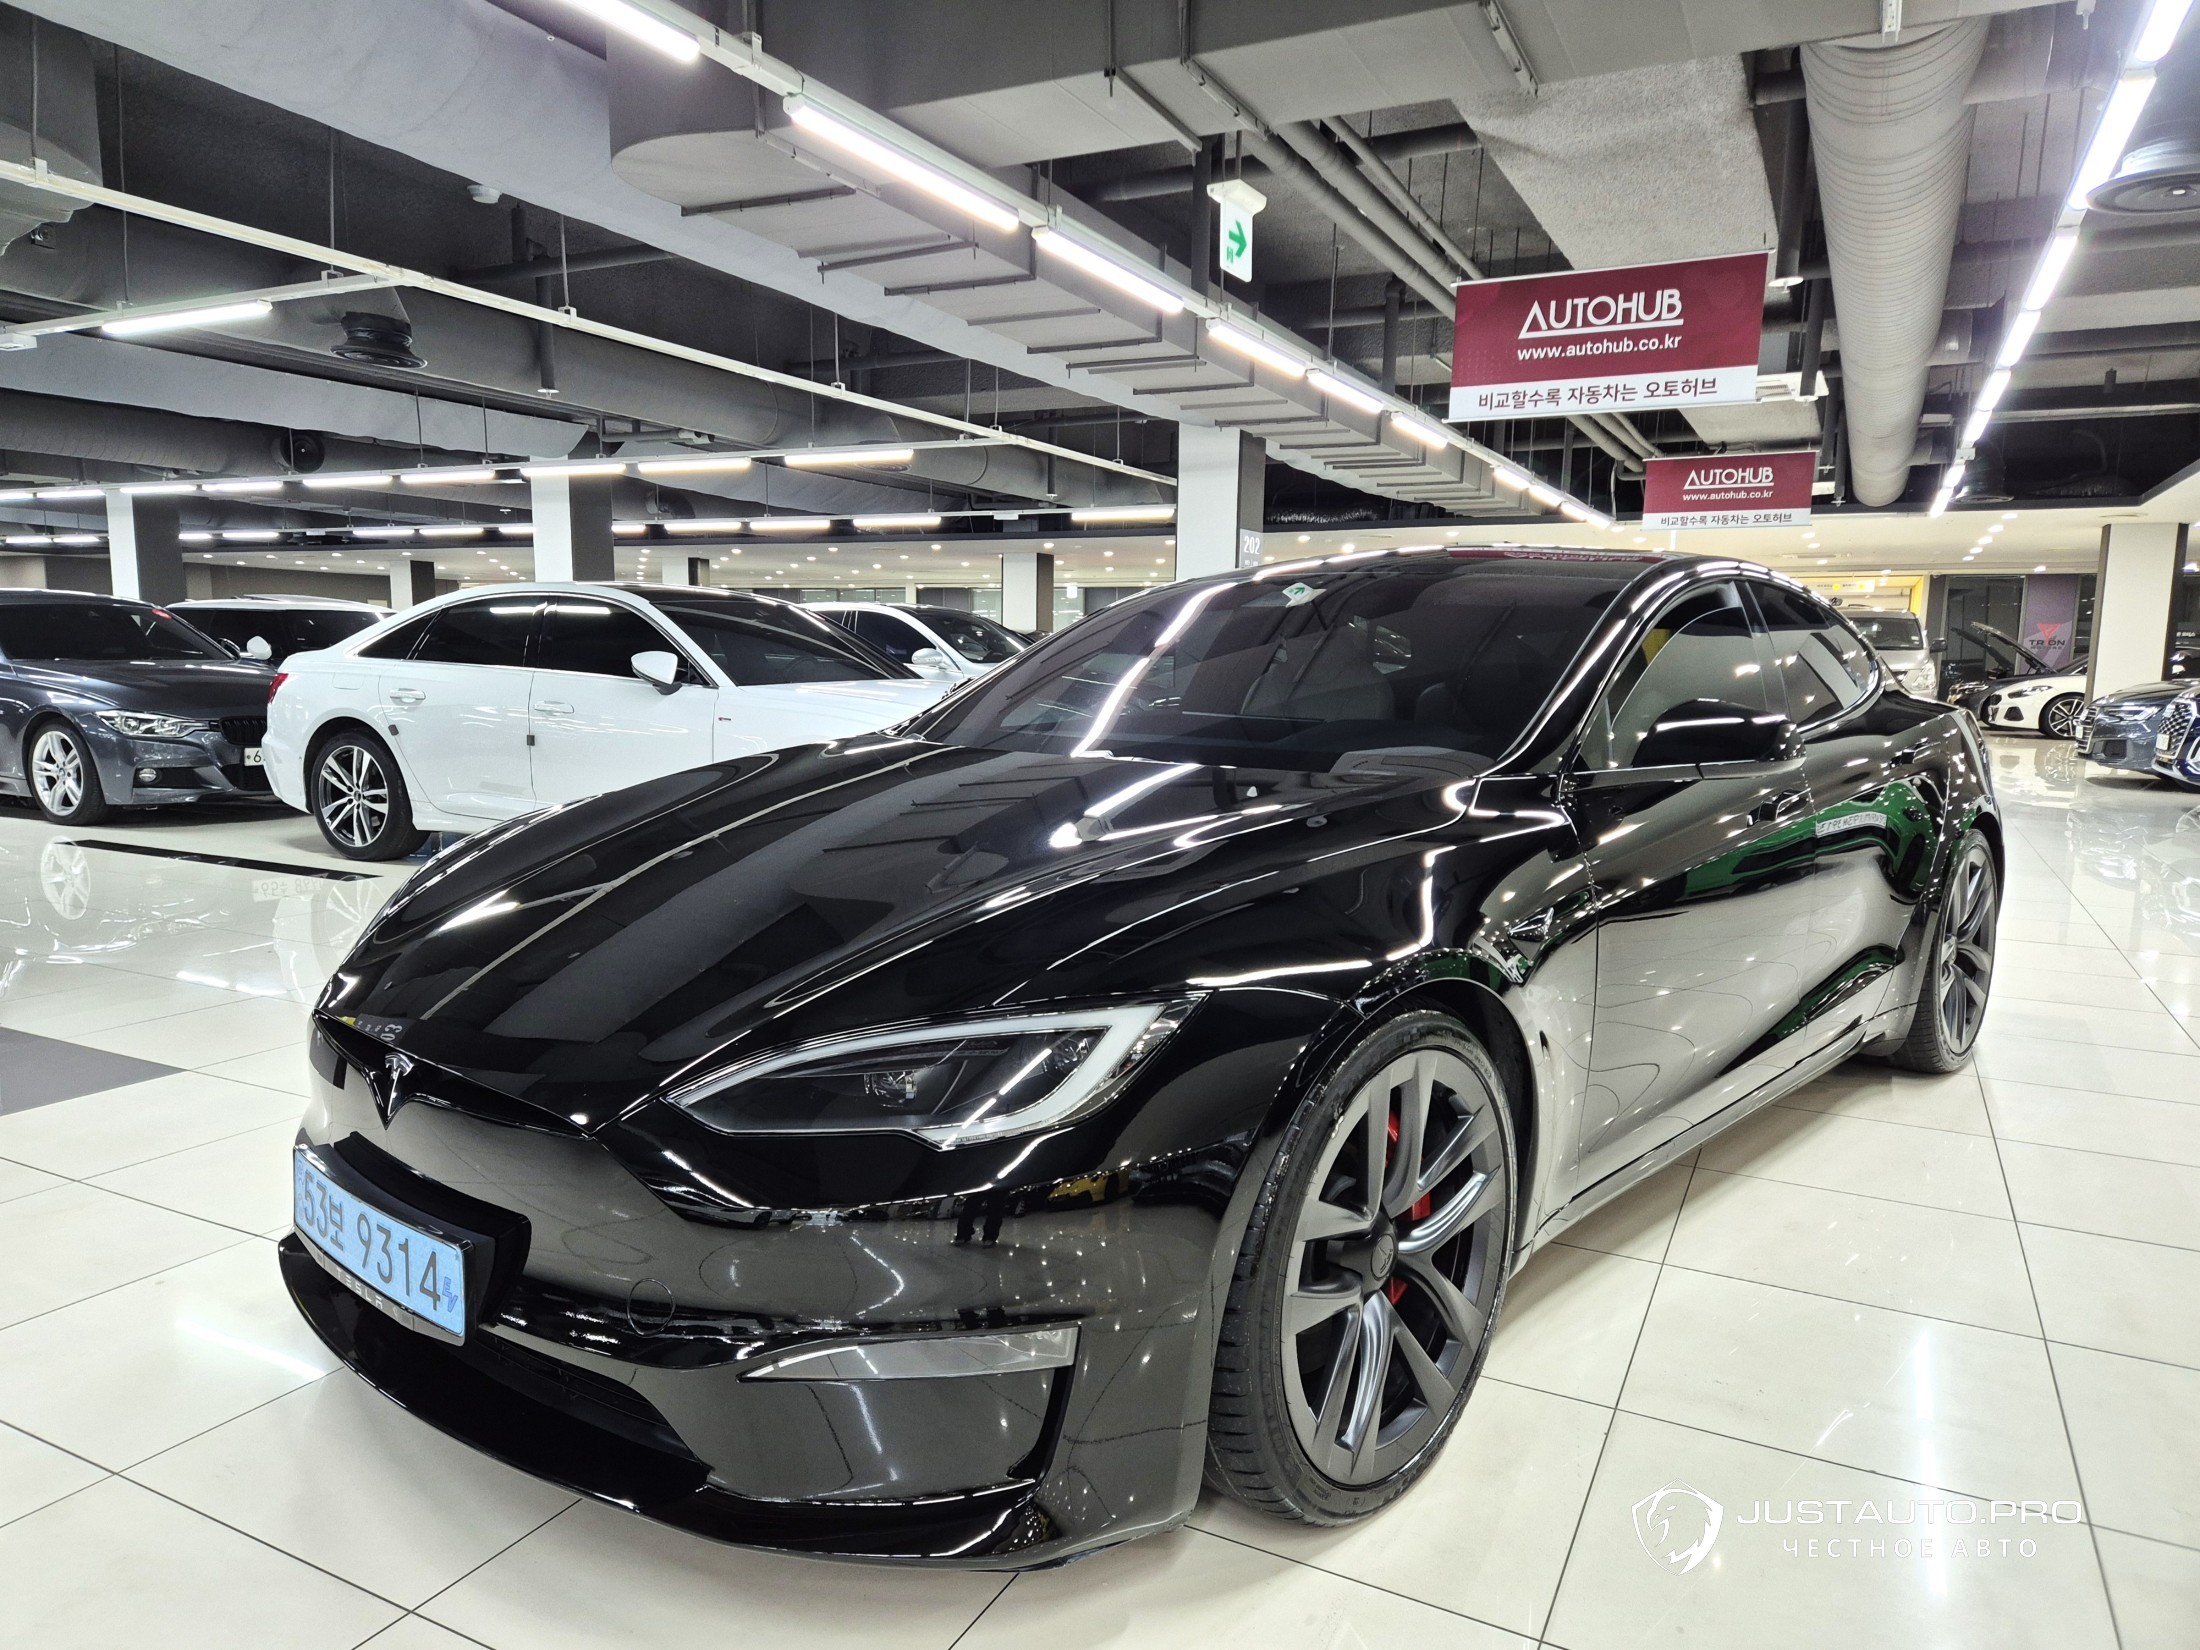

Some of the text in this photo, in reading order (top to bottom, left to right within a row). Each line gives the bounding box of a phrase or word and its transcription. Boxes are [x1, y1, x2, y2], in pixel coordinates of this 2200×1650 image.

[1518, 288, 1684, 339] AUTOHUB
[1517, 333, 1682, 361] www.autohub.co.kr
[1478, 376, 1718, 411] 비교할수록 자동차는 오토허브
[1683, 466, 1774, 490] AUTOHUB
[1682, 489, 1774, 501] www.autohub.co.kr
[1660, 513, 1793, 527] 비교할수록 자동차는 오토허브
[1243, 535, 1260, 555] 202
[304, 1169, 344, 1251] 53보
[356, 1212, 441, 1311] 9314
[336, 1267, 383, 1310] TESLA
[442, 1276, 458, 1312] EV
